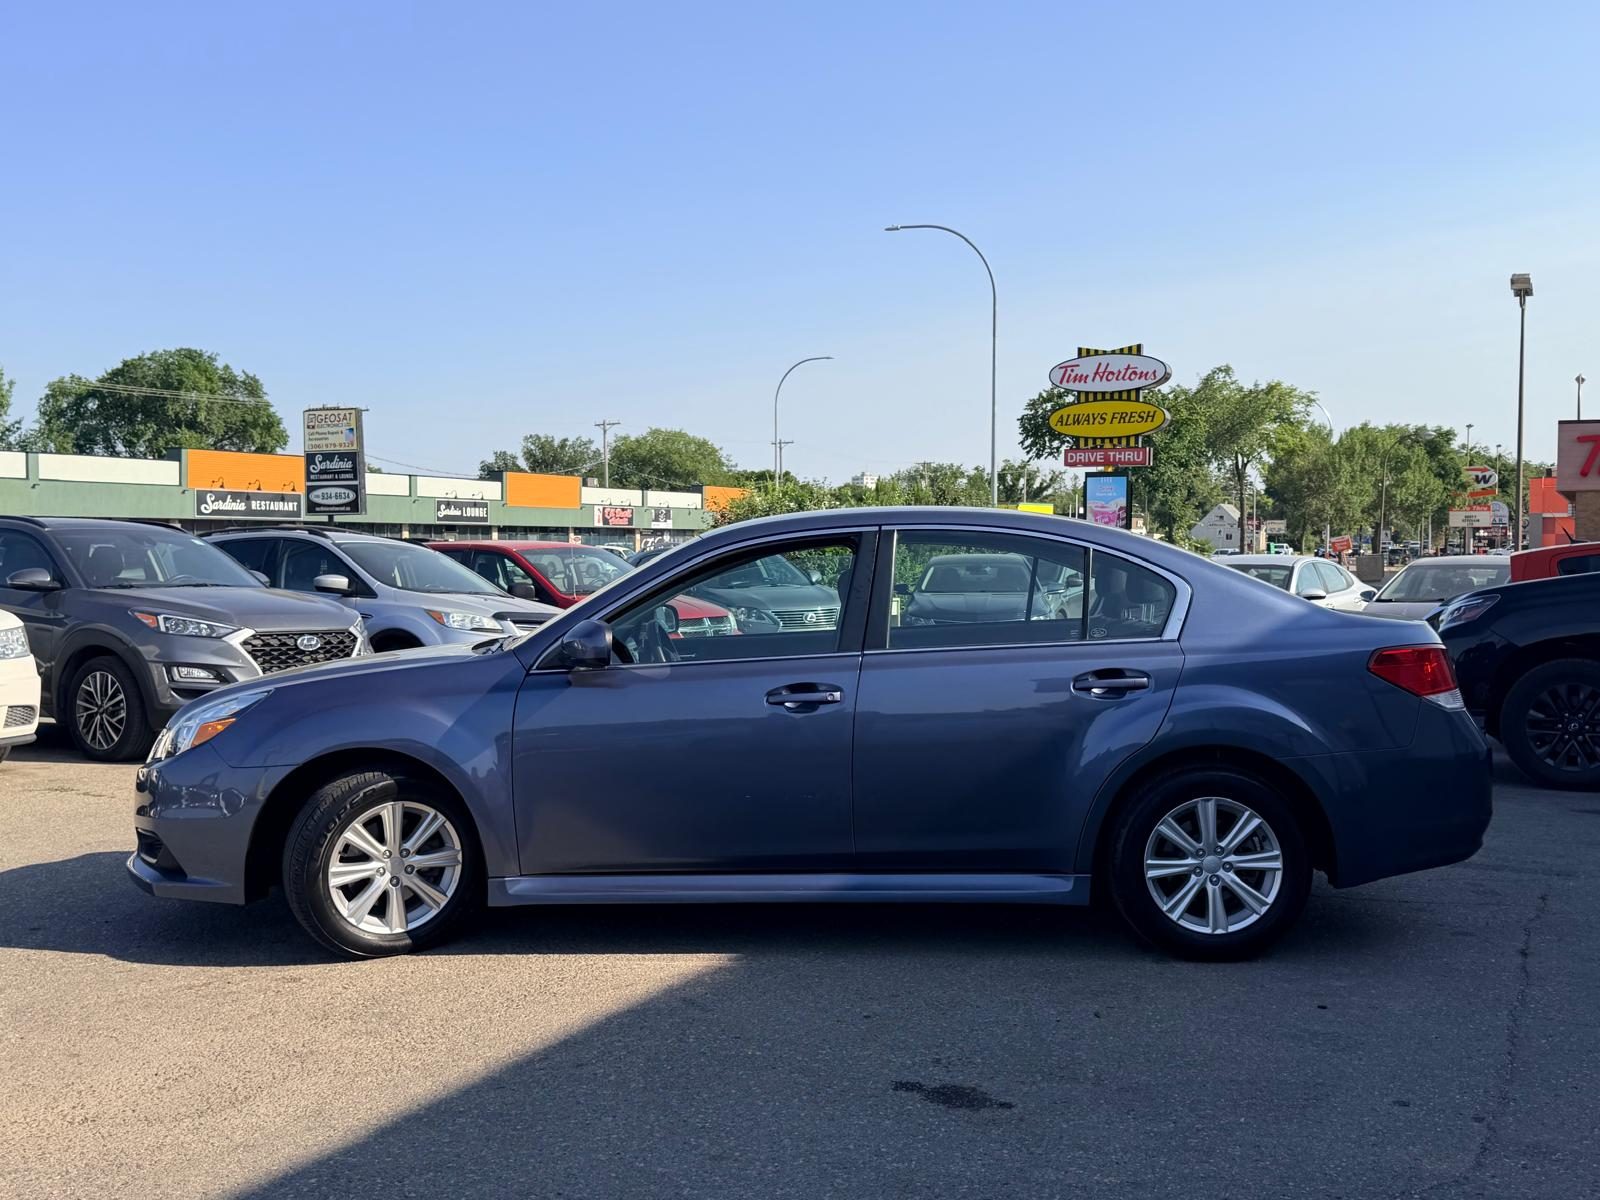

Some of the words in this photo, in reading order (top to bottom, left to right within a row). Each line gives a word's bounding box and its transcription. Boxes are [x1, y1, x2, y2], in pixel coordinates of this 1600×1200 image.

[1058, 363, 1089, 385] Tim
[1092, 362, 1157, 383] Hortons
[316, 412, 353, 424] GEOSAT
[1055, 412, 1108, 427] ALWAYS
[1109, 410, 1157, 425] FRESH
[310, 454, 353, 473] Sardinia
[1067, 452, 1105, 463] DRIVE
[1108, 450, 1143, 462] THRU
[200, 493, 246, 514] Sardinia
[251, 500, 298, 512] RESTAURANT
[321, 491, 350, 501] 934-6634
[462, 506, 488, 518] LOUNGE
